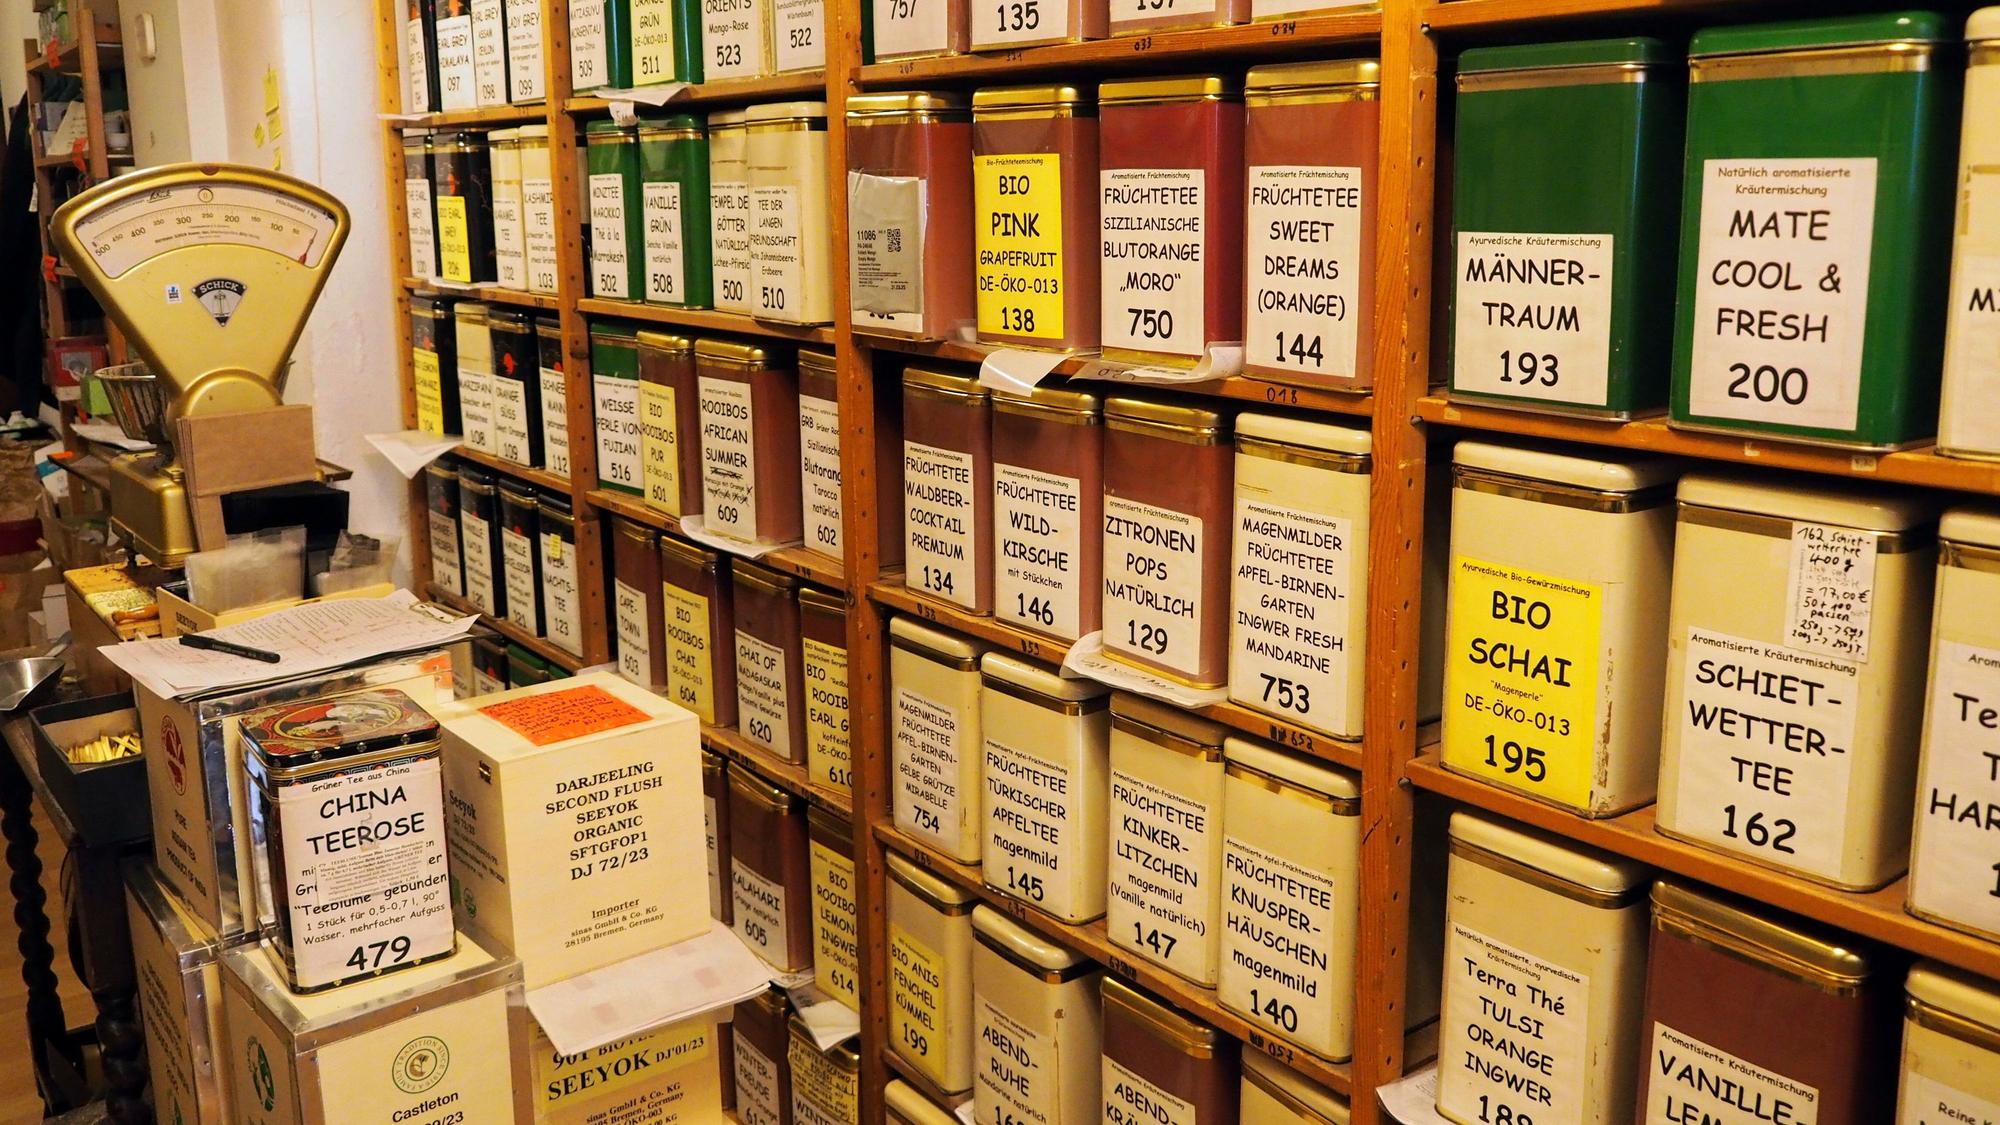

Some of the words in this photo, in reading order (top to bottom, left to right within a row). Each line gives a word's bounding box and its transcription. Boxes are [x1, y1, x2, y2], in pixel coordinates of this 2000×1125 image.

[998, 2, 1040, 32] 135
[790, 29, 812, 47] 522
[641, 56, 660, 73] 511
[717, 46, 741, 66] 523
[1000, 176, 1029, 195] BIO
[1260, 171, 1297, 179] Aromatisierte
[1299, 171, 1349, 180] Früchtemischung
[1718, 168, 1768, 178] Natürlich
[1773, 169, 1850, 178] aromatisierte
[645, 196, 677, 210] VANILLE
[1105, 186, 1197, 205] FRÜCHTETEE
[1253, 187, 1358, 207] FRÜCHTETEE
[1736, 184, 1827, 198] Kräutermischung
[651, 217, 671, 232] GRÜN
[717, 217, 744, 232] GÖTTER
[992, 213, 1040, 237] PINK
[1103, 216, 1199, 232] SIZILIANISCHE
[1271, 221, 1334, 242] SWEET
[1730, 211, 1830, 241] MATE
[1103, 243, 1199, 262] BLUTORANGE
[1469, 236, 1523, 246] Ayurvedische
[1527, 236, 1601, 249] Kräutermischung
[980, 250, 1057, 268] GRAPEFRUIT
[1265, 256, 1338, 279] DREAMS
[1466, 254, 1600, 284] MÄNNER-
[600, 274, 617, 292] 502
[653, 274, 672, 293] 508
[723, 280, 742, 300] 500
[980, 273, 1058, 294] DE-ÖKO-013
[1713, 260, 1801, 290] COOL
[1820, 265, 1841, 293] &
[762, 287, 784, 309] 510
[1258, 292, 1345, 322] (ORANGE)
[1002, 308, 1034, 331] 138
[1128, 309, 1173, 339] 750
[1483, 303, 1580, 332] TRAUM
[1717, 310, 1828, 342] FRESH
[1276, 333, 1323, 367] 144
[1500, 350, 1558, 386] 193
[1729, 363, 1807, 404] 200
[702, 399, 748, 419] ROOIBOS
[704, 424, 748, 444] AFRICAN
[611, 462, 630, 480] 516
[706, 448, 747, 468] SUMMER
[906, 457, 969, 483] FRÜCHTETEE
[906, 481, 971, 508] WALDBEER-
[997, 481, 1076, 511] FRÜCHTETEE
[718, 504, 738, 524] 609
[910, 508, 965, 535] COCKTAIL
[1010, 510, 1058, 537] WILD-
[818, 525, 836, 546] 602
[912, 534, 964, 561] PREMIUM
[1106, 515, 1195, 553] ZITRONEN
[1242, 518, 1342, 551] MAGENMILDER
[1798, 527, 1824, 543] 162
[1003, 538, 1068, 571] KIRSCHE
[1126, 553, 1167, 580] POPS
[1248, 542, 1333, 575] FRÜCHTETEE
[924, 565, 953, 595] 134
[1008, 568, 1020, 579] mit
[1023, 572, 1063, 590] Stückchen
[1238, 567, 1345, 600] APFEL-BIRNEN-
[1462, 563, 1508, 579] Ayurvedische
[1511, 572, 1590, 597] Bio-Gewürzmischung
[1017, 593, 1054, 626] 146
[1106, 581, 1194, 618] NATÜRLICH
[1260, 594, 1315, 620] GARTEN
[1492, 592, 1550, 629] BIO
[1128, 620, 1168, 655] 129
[1238, 611, 1292, 641] INGWER
[1295, 627, 1343, 651] FRESH
[676, 650, 695, 667] CHAI
[740, 645, 761, 666] CHAI
[763, 654, 777, 670] OF
[1246, 639, 1330, 674] MANDARINE
[1469, 638, 1571, 686] SCHAI
[1691, 634, 1760, 657] Aromatisierte
[1764, 648, 1856, 675] Kräutermischung
[680, 686, 696, 704] 604
[1260, 673, 1310, 714] 753
[1696, 661, 1842, 705] SCHIET-
[750, 718, 771, 743] 620
[1465, 694, 1570, 736] DE-ÖKO-013
[1689, 701, 1845, 755] WETTER-
[1485, 735, 1546, 780] 195
[311, 779, 344, 793] Grüner
[347, 775, 364, 785] Tee
[367, 773, 383, 781] aus
[386, 766, 410, 777] China
[555, 761, 654, 795] DARJEELING
[900, 763, 925, 784] GELBE
[927, 772, 955, 797] GRÜTZE
[1731, 757, 1793, 795] TEE
[320, 785, 407, 819] CHINA
[546, 790, 610, 816] SECOND
[614, 777, 663, 800] FLUSH
[906, 782, 948, 810] MIRABELLE
[987, 776, 1066, 820] TÜRKISCHER
[576, 800, 639, 825] SEEYOK
[913, 805, 940, 834] 754
[993, 806, 1059, 845] APFELTEE
[306, 812, 425, 854] TEEROSE
[573, 815, 644, 843] ORGANIC
[1123, 815, 1189, 854] KINKER-
[1723, 805, 1797, 854] 162
[570, 830, 647, 863] SFTGFOP1
[993, 832, 1058, 871] magenmild
[570, 864, 595, 882] DJ
[599, 848, 649, 875] 72/23
[1117, 840, 1197, 888] LITZCHEN
[1007, 866, 1044, 902] 145
[1128, 872, 1183, 905] magenmild
[591, 897, 640, 921] Importer
[1111, 882, 1146, 911] (Vanille
[1149, 902, 1206, 935] natürlich)
[1231, 886, 1321, 934] KNUSPER-
[590, 926, 627, 944] Bremen,
[628, 912, 665, 933] Germany
[745, 919, 767, 946] 605
[1135, 922, 1177, 959] 147
[1227, 912, 1327, 971] HÄUSCHEN
[346, 935, 412, 971] 479
[892, 944, 909, 965] BIO
[912, 961, 939, 988] ANIS
[831, 970, 854, 994] 614
[1233, 949, 1317, 997] magenmild
[1464, 958, 1516, 996] Terra
[1527, 984, 1566, 1015] Thé
[893, 969, 936, 1009] FENCHEL
[895, 991, 935, 1031] KÜMMEL
[1250, 988, 1297, 1033] 140
[1479, 996, 1543, 1039] TULSI
[902, 1022, 928, 1058] 199
[982, 1025, 1039, 1070] ABEND-
[1468, 1024, 1554, 1075] ORANGE
[547, 1048, 652, 1100] SEEYOK
[991, 1058, 1030, 1097] RUHE
[1465, 1051, 1552, 1106] INGWER
[392, 1091, 459, 1124] Castleton
